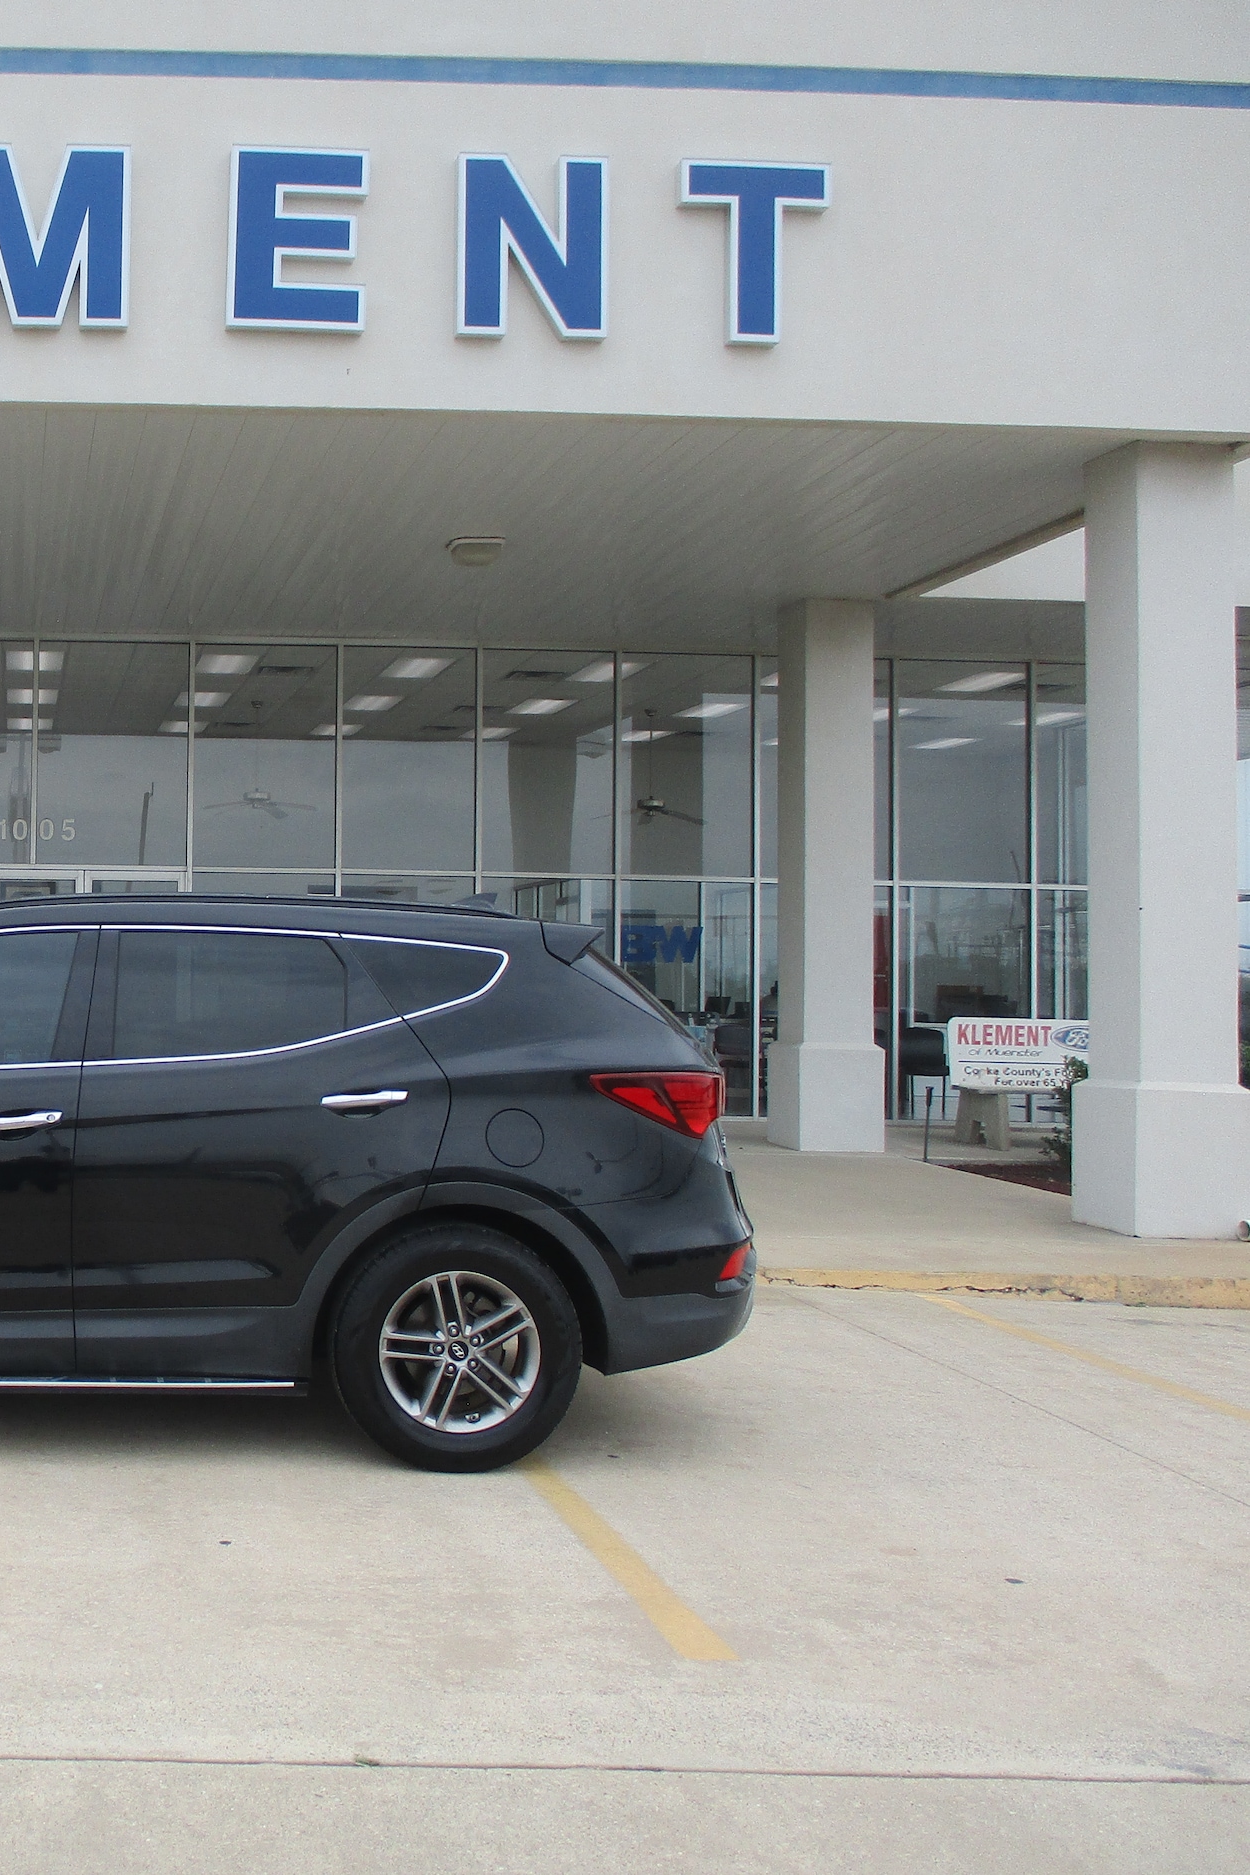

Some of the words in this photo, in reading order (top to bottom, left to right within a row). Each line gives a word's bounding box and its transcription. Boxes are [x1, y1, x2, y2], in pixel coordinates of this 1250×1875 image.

[957, 1023, 1052, 1047] KLEMENT
[985, 1048, 1043, 1057] Muenster
[964, 1065, 999, 1076] Coke
[1002, 1067, 1051, 1078] County's
[1043, 1078, 1056, 1087] 65
